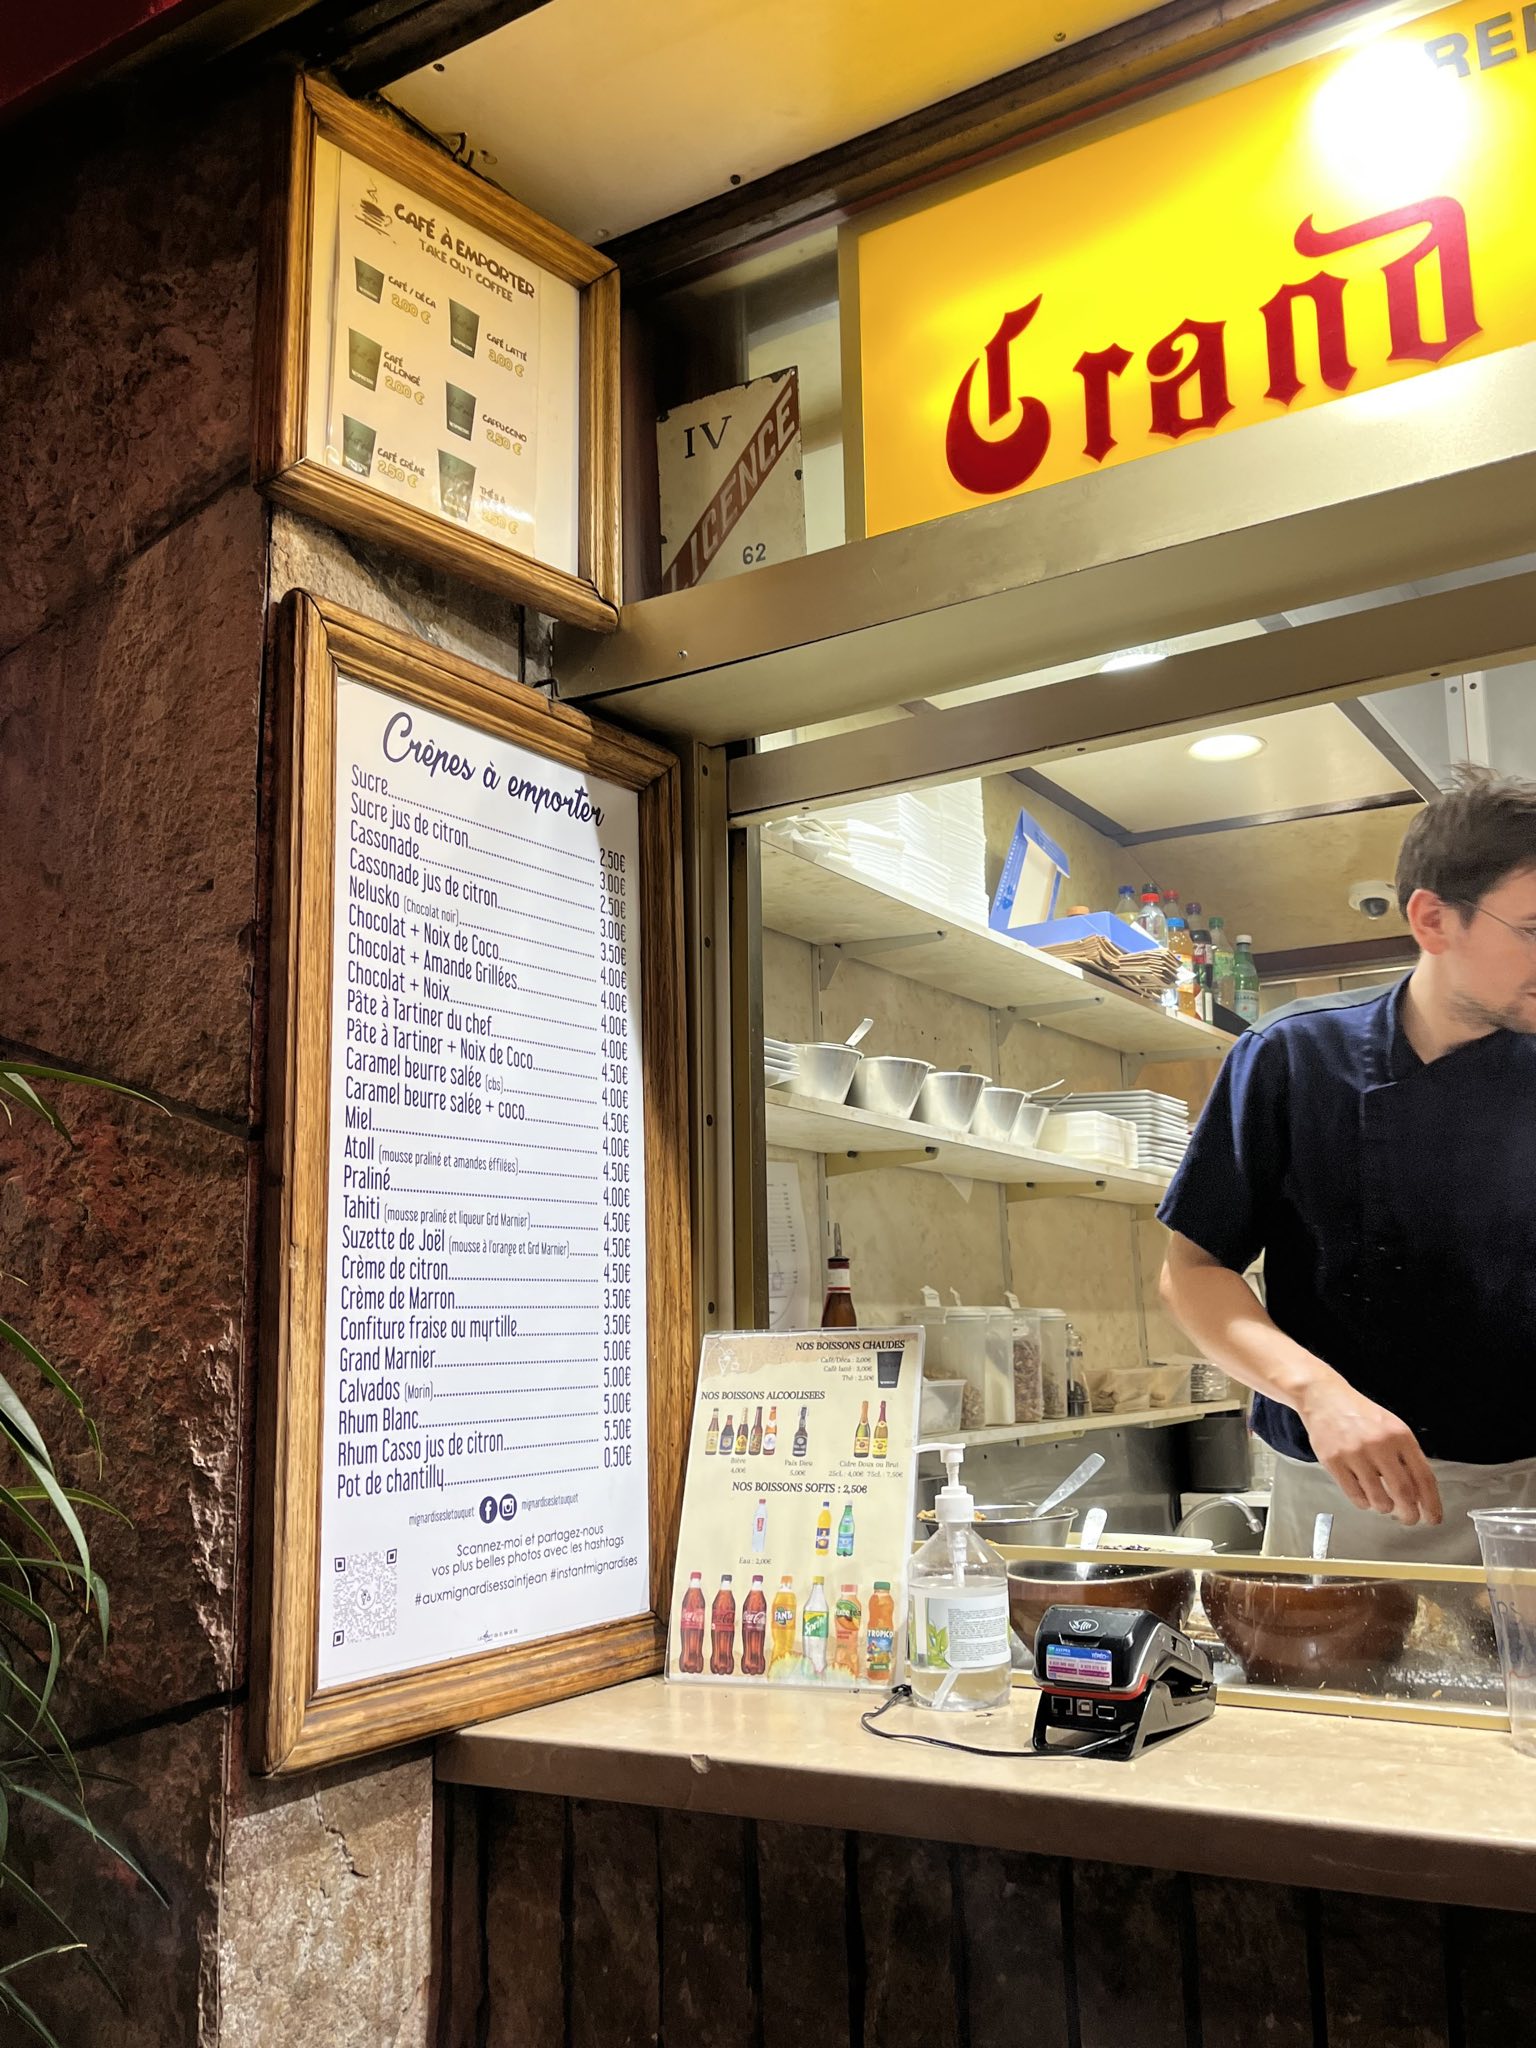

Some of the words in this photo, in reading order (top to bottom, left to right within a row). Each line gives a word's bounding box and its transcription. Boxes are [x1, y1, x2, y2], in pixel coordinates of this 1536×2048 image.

[394, 203, 435, 239] CAFÉ
[440, 227, 453, 250] À
[456, 239, 535, 298] EMPORTER
[419, 238, 448, 264] TAKE
[450, 258, 473, 278] OUT
[476, 273, 513, 302] COFFEE
[388, 276, 408, 292] CAFÉ
[384, 351, 403, 368] CAFÉ
[487, 333, 504, 349] CAFÉ
[945, 195, 1483, 495] Grand
[384, 362, 421, 386] ALLONGÉ
[378, 448, 397, 464] CAFÉ
[684, 415, 732, 458] IV
[743, 543, 766, 565] 62
[383, 712, 476, 780] Crêpes
[482, 761, 501, 790] à
[508, 775, 605, 827] emporter
[351, 764, 388, 796] Sucre
[599, 848, 626, 874] 2.50€
[351, 792, 388, 823] Sucre
[390, 804, 410, 830] jus
[414, 813, 428, 835] de
[432, 820, 469, 848] citron
[599, 871, 626, 897] 3.00€
[350, 820, 420, 860] Cassonade
[600, 895, 626, 920] 2.50€
[350, 848, 419, 887] Cassonade
[421, 868, 441, 894] jus
[445, 876, 459, 898] de
[463, 881, 498, 909] citron
[600, 919, 626, 943] 3.00€
[349, 875, 400, 908] Nelusko
[404, 895, 440, 920] (Chocolat
[441, 906, 459, 927] noir)
[600, 943, 627, 966] 3.50€
[349, 904, 406, 938] Chocolat
[424, 922, 450, 949] Noix
[454, 929, 468, 952] de
[472, 935, 499, 959] Coco
[600, 967, 627, 990] 4.00€
[348, 932, 406, 966] Chocolat
[424, 950, 472, 980] Amande
[475, 957, 518, 990] Grillées
[600, 990, 627, 1014] 4.00€
[348, 960, 405, 993] Chocolat
[424, 978, 450, 1002] Noix
[600, 1014, 628, 1037] 4.00€
[347, 989, 377, 1016] Pâte
[381, 993, 389, 1017] à
[393, 998, 442, 1028] Tartiner
[447, 1008, 462, 1032] du
[465, 1015, 492, 1037] chef
[600, 1039, 628, 1061] 4.00€
[347, 1018, 377, 1044] Pâte
[381, 1022, 389, 1046] à
[393, 1026, 443, 1055] Tartiner
[460, 1037, 486, 1062] Noix
[489, 1043, 503, 1065] de
[506, 1047, 533, 1070] Coco
[601, 1063, 628, 1085] 4.50€
[346, 1047, 400, 1076] Caramel
[405, 1055, 446, 1083] beurre
[450, 1065, 482, 1088] salée
[486, 1074, 504, 1093] (cbs)
[602, 1087, 629, 1109] 4.00€
[345, 1076, 399, 1104] Caramel
[404, 1084, 446, 1112] beurre
[450, 1093, 482, 1119] salée
[498, 1101, 525, 1121] coco
[603, 1111, 629, 1134] 4.50€
[345, 1105, 373, 1131] Miel
[603, 1136, 629, 1158] 4.00€
[344, 1135, 374, 1160] Atoll
[379, 1144, 413, 1165] (mousse
[415, 1150, 441, 1167] praliné
[443, 1151, 451, 1168] et
[454, 1154, 487, 1171] amandes
[603, 1161, 630, 1183] 4.50€
[344, 1165, 391, 1191] Praliné
[603, 1187, 630, 1207] 4.00€
[343, 1195, 380, 1220] Tahiti
[384, 1203, 418, 1224] (mousse
[420, 1208, 447, 1224] praliné
[449, 1210, 457, 1225] et
[603, 1212, 630, 1233] 4.50€
[342, 1225, 395, 1250] Suzette
[399, 1227, 415, 1251] de
[418, 1228, 445, 1252] Joël
[482, 1237, 487, 1253] à
[519, 1242, 525, 1255] et
[604, 1237, 630, 1258] 4.50€
[342, 1255, 385, 1280] Crème
[390, 1256, 405, 1280] de
[410, 1256, 448, 1281] citron
[604, 1263, 631, 1283] 4.50€
[341, 1286, 384, 1309] Crème
[390, 1287, 405, 1309] de
[409, 1288, 456, 1309] Marron
[604, 1288, 631, 1309] 3.50€
[340, 1315, 405, 1340] Confiture
[409, 1316, 447, 1339] fraise
[451, 1321, 466, 1338] ou
[470, 1315, 517, 1342] myrtille
[604, 1314, 631, 1335] 3.50€
[796, 1342, 814, 1350] NOS
[816, 1341, 860, 1350] BOISSONS
[863, 1339, 905, 1349] CHAUDES
[340, 1347, 380, 1371] Grand
[384, 1345, 435, 1369] Marnier
[604, 1340, 631, 1361] 5.00€
[340, 1376, 400, 1403] Calvados
[405, 1381, 433, 1402] (Morin)
[604, 1366, 631, 1388] 5.00€
[702, 1391, 720, 1400] NOS
[721, 1391, 764, 1400] BOISSONS
[766, 1391, 825, 1400] ALCOOLISEES
[339, 1410, 378, 1435] Rhum
[383, 1407, 419, 1432] Blanc
[604, 1392, 631, 1414] 5.00€
[338, 1441, 377, 1467] Rhum
[382, 1438, 421, 1463] Casso
[424, 1437, 444, 1464] jus
[448, 1432, 463, 1455] de
[467, 1431, 504, 1454] citron
[604, 1418, 631, 1441] 5.50€
[338, 1474, 361, 1499] Pot
[365, 1473, 381, 1494] de
[386, 1464, 445, 1493] chantilly
[604, 1446, 632, 1468] 0.50€
[732, 1482, 753, 1492] NOS
[755, 1482, 803, 1492] BOISSONS
[805, 1483, 835, 1493] SOFTS
[432, 1564, 450, 1576] vos
[452, 1556, 474, 1574] plus
[476, 1554, 506, 1570] belles
[508, 1549, 542, 1566] photos
[544, 1545, 568, 1559] avec
[570, 1540, 582, 1555] les
[584, 1534, 624, 1554] hashtags
[457, 1534, 523, 1558] Scannez-moi
[525, 1532, 535, 1546] et
[538, 1524, 604, 1546] partagez-nous
[415, 1571, 548, 1606] #auxmignardisessaintjean
[550, 1555, 638, 1581] #instantmignardises
[868, 1630, 894, 1638] TROPICO
